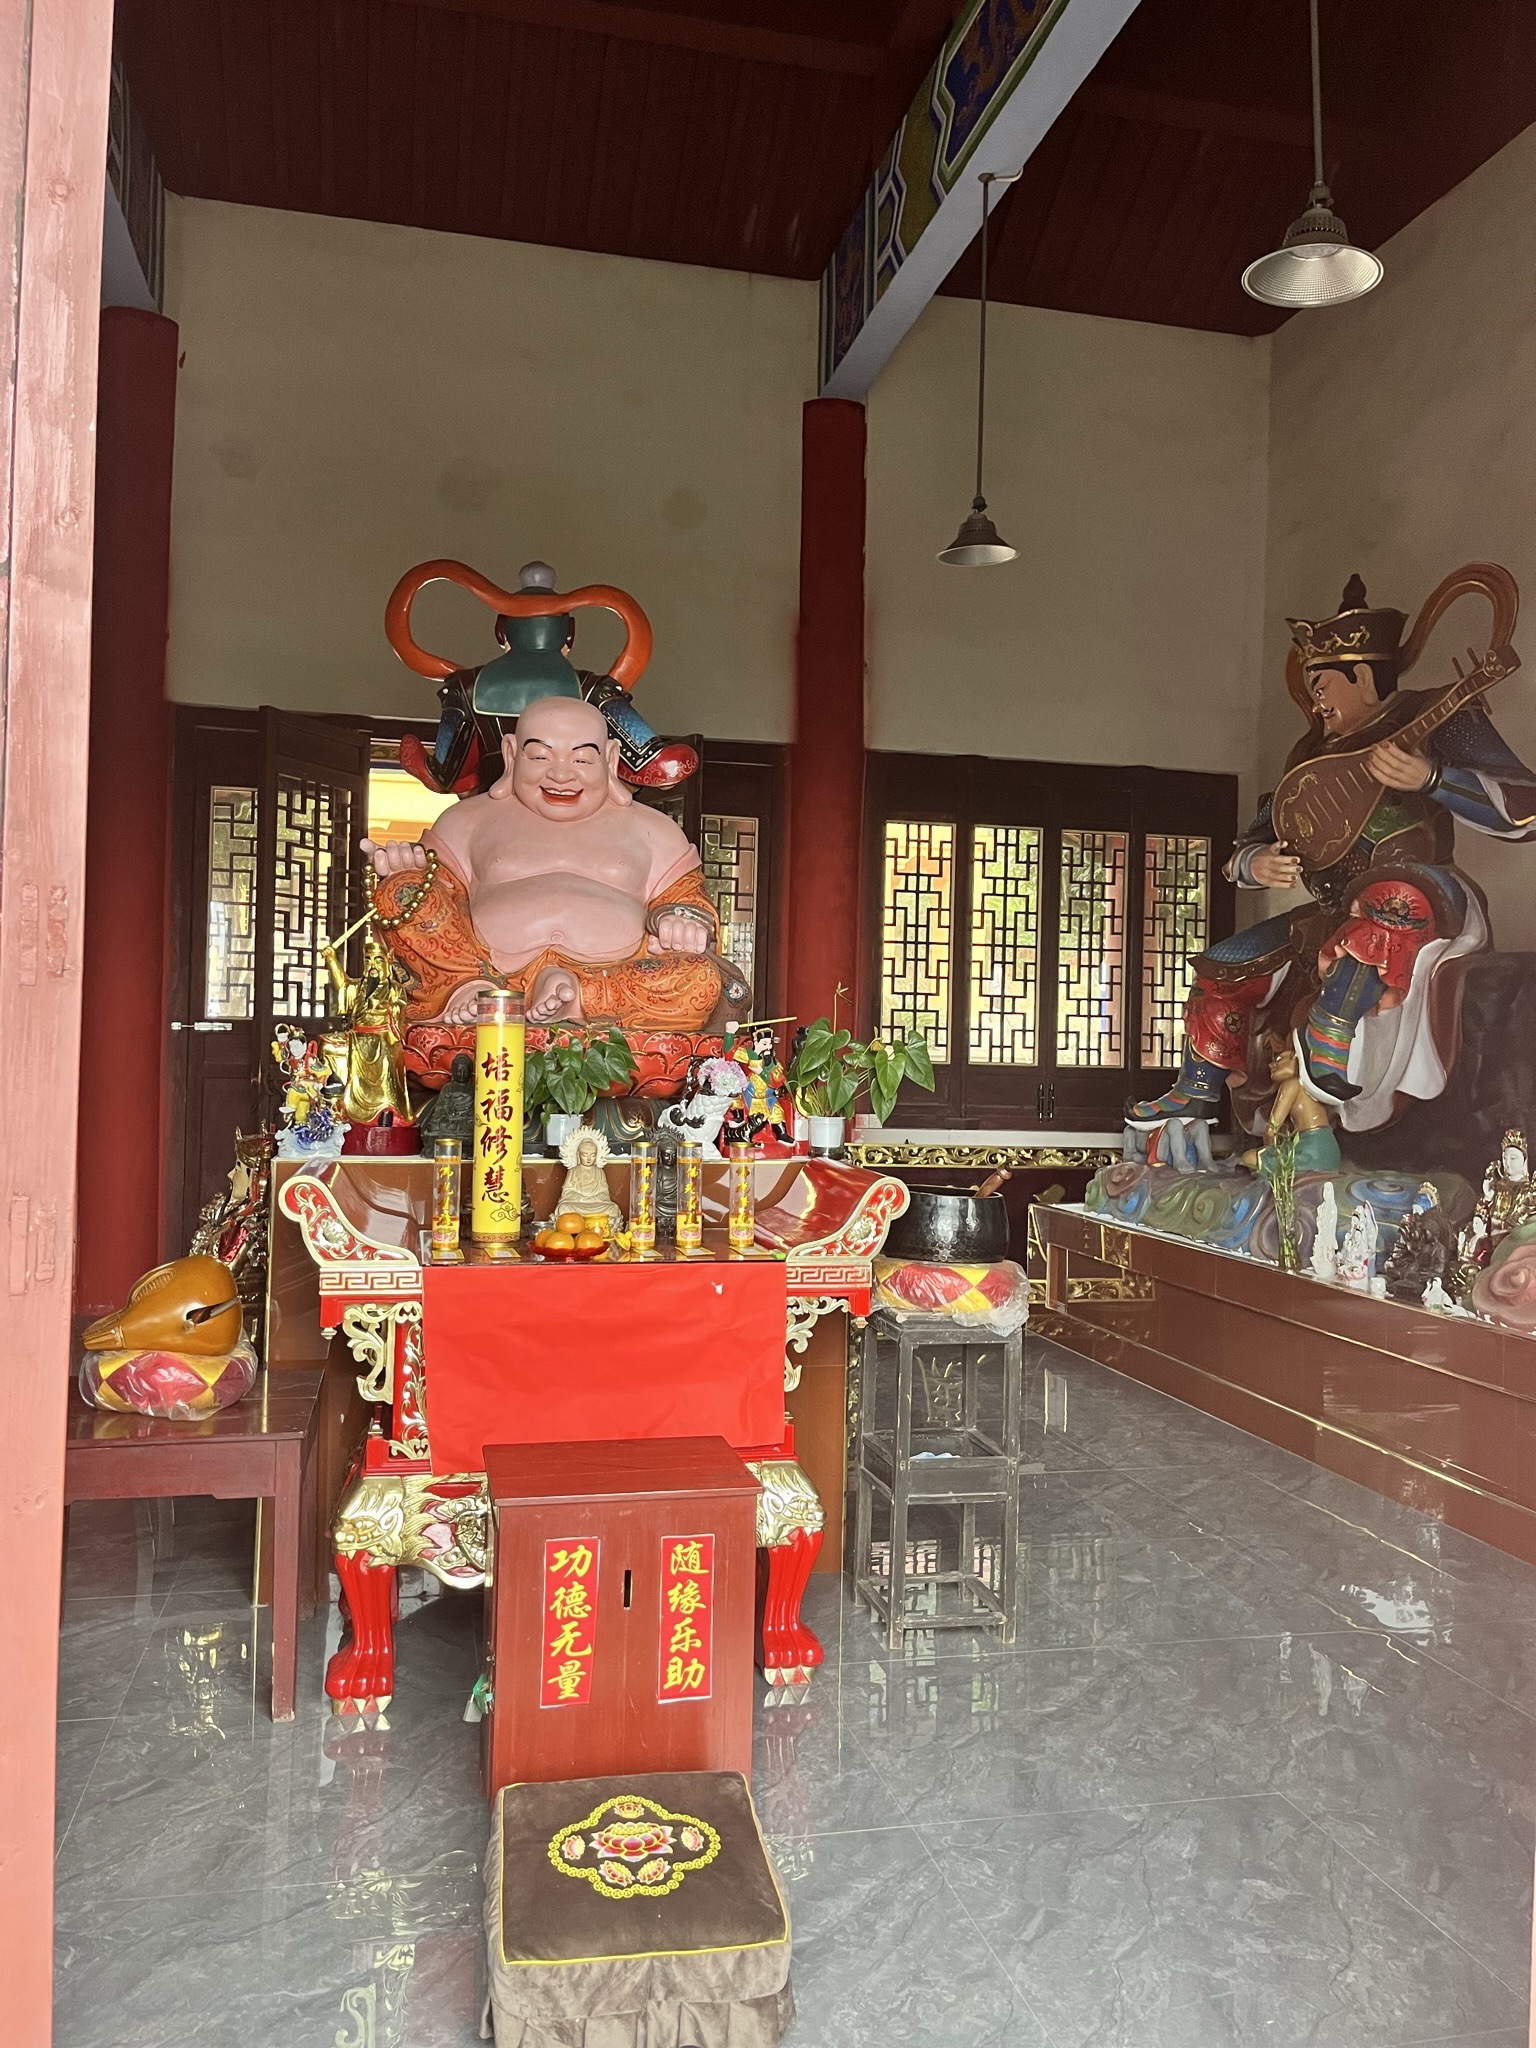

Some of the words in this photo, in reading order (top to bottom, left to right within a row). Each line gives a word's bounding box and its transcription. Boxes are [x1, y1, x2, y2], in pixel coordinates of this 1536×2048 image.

[480, 1047, 514, 1204] 培福修慧
[549, 1545, 593, 1699] 功德无量
[664, 1541, 709, 1692] 随缘乐助
